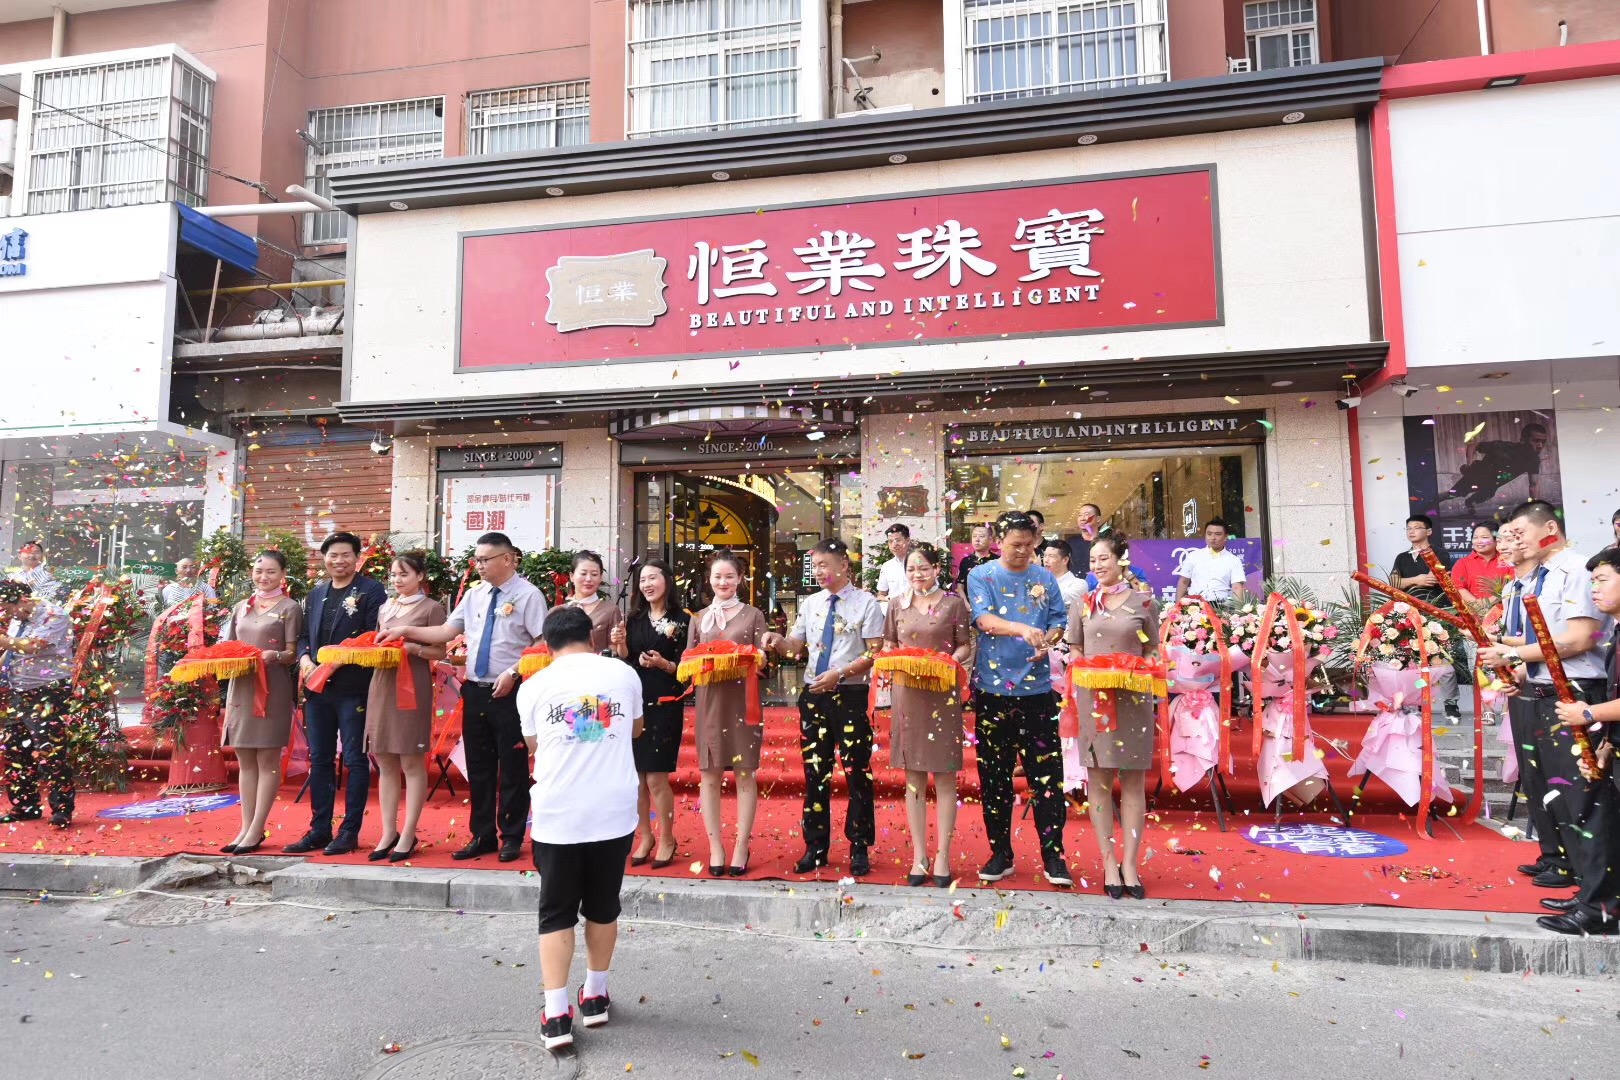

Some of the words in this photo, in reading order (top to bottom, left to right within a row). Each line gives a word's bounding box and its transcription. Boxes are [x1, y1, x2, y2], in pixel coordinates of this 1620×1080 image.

[687, 208, 1105, 305] 恒業珠寶
[576, 281, 638, 306] 恒業
[690, 304, 836, 329] BEAUTIFUL
[844, 301, 894, 319] AND
[904, 285, 1100, 314] INTELLIGENT
[463, 451, 497, 463] SINCE
[507, 450, 533, 461] 2000
[698, 442, 735, 454] SINCE
[746, 441, 774, 452] 2000
[467, 511, 505, 531] 國潮
[546, 697, 625, 724] 摄制组
